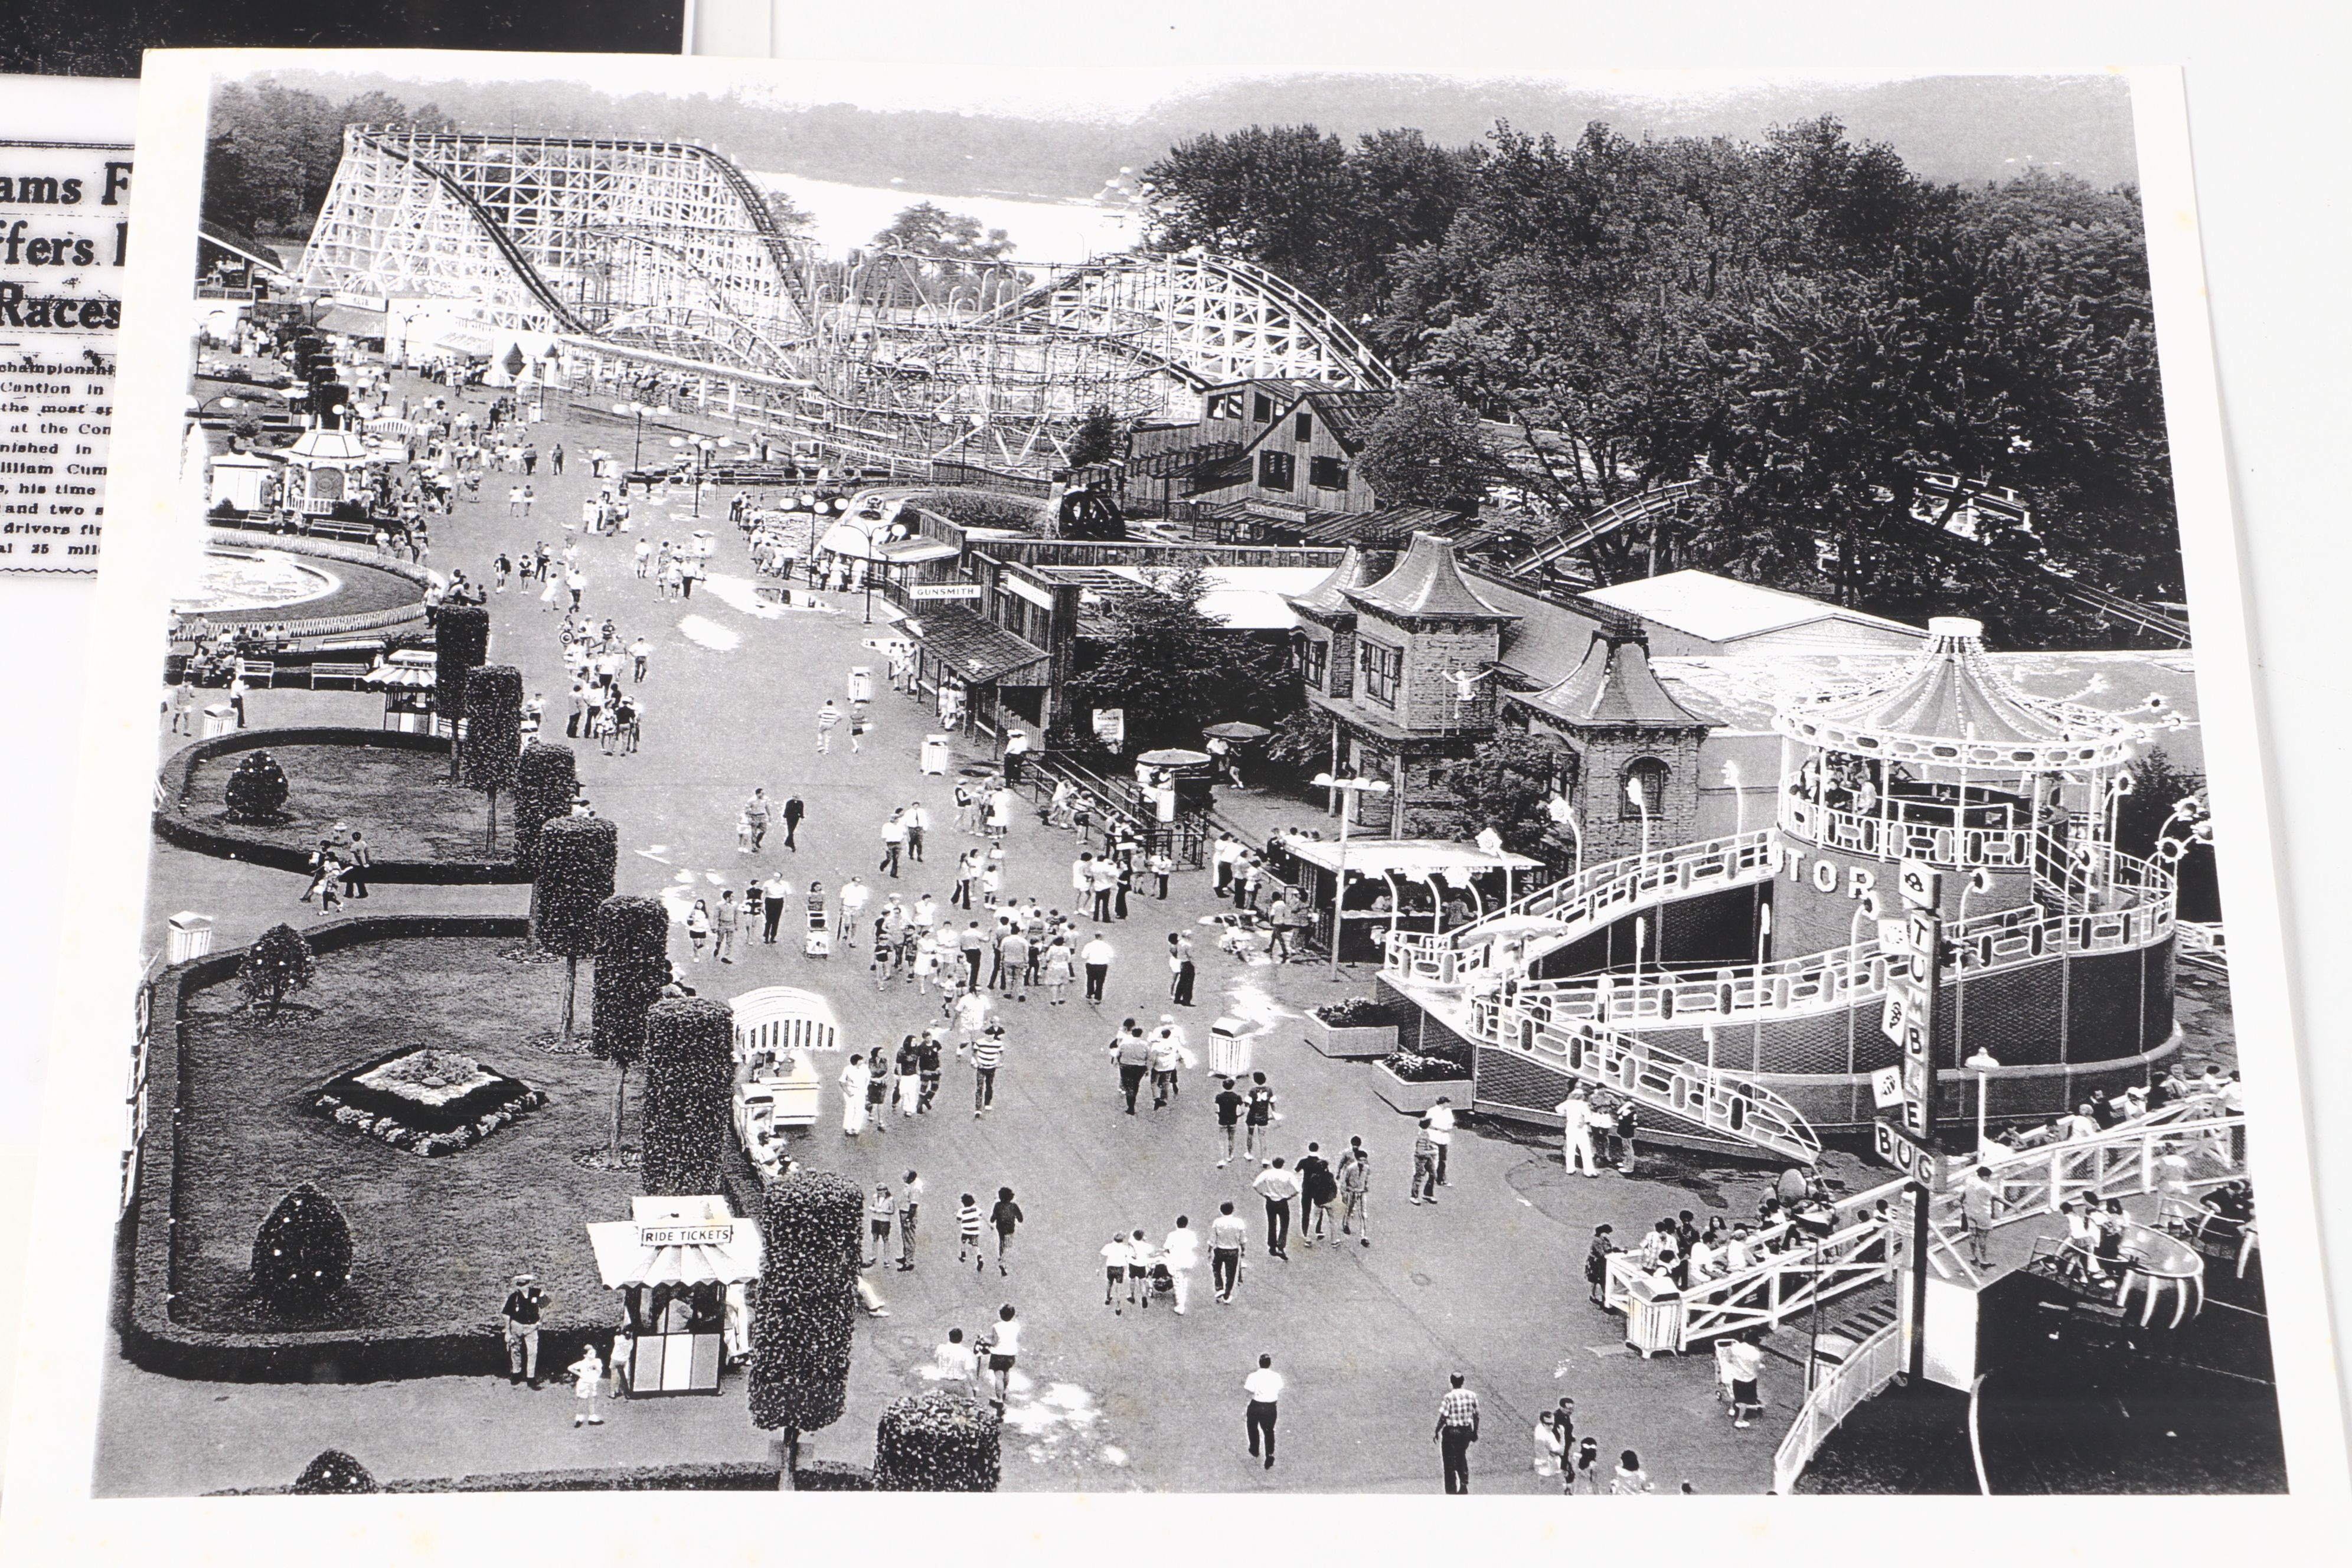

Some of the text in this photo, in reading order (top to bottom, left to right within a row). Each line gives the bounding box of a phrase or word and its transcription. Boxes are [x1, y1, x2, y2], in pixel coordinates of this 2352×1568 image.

[0, 282, 122, 329] Races
[87, 384, 103, 395] in
[2, 402, 29, 412] the
[41, 404, 85, 414] most
[10, 423, 111, 435] at the Con
[0, 442, 92, 455] nished in
[67, 464, 107, 475] Cum
[19, 483, 46, 494] his
[55, 484, 96, 495] time
[5, 503, 38, 514] and
[50, 504, 84, 515] two
[4, 522, 70, 535] drivers
[67, 544, 100, 555] mil
[1878, 1126, 1931, 1184] BUG
[645, 1230, 730, 1242] RIDE TICKETS
